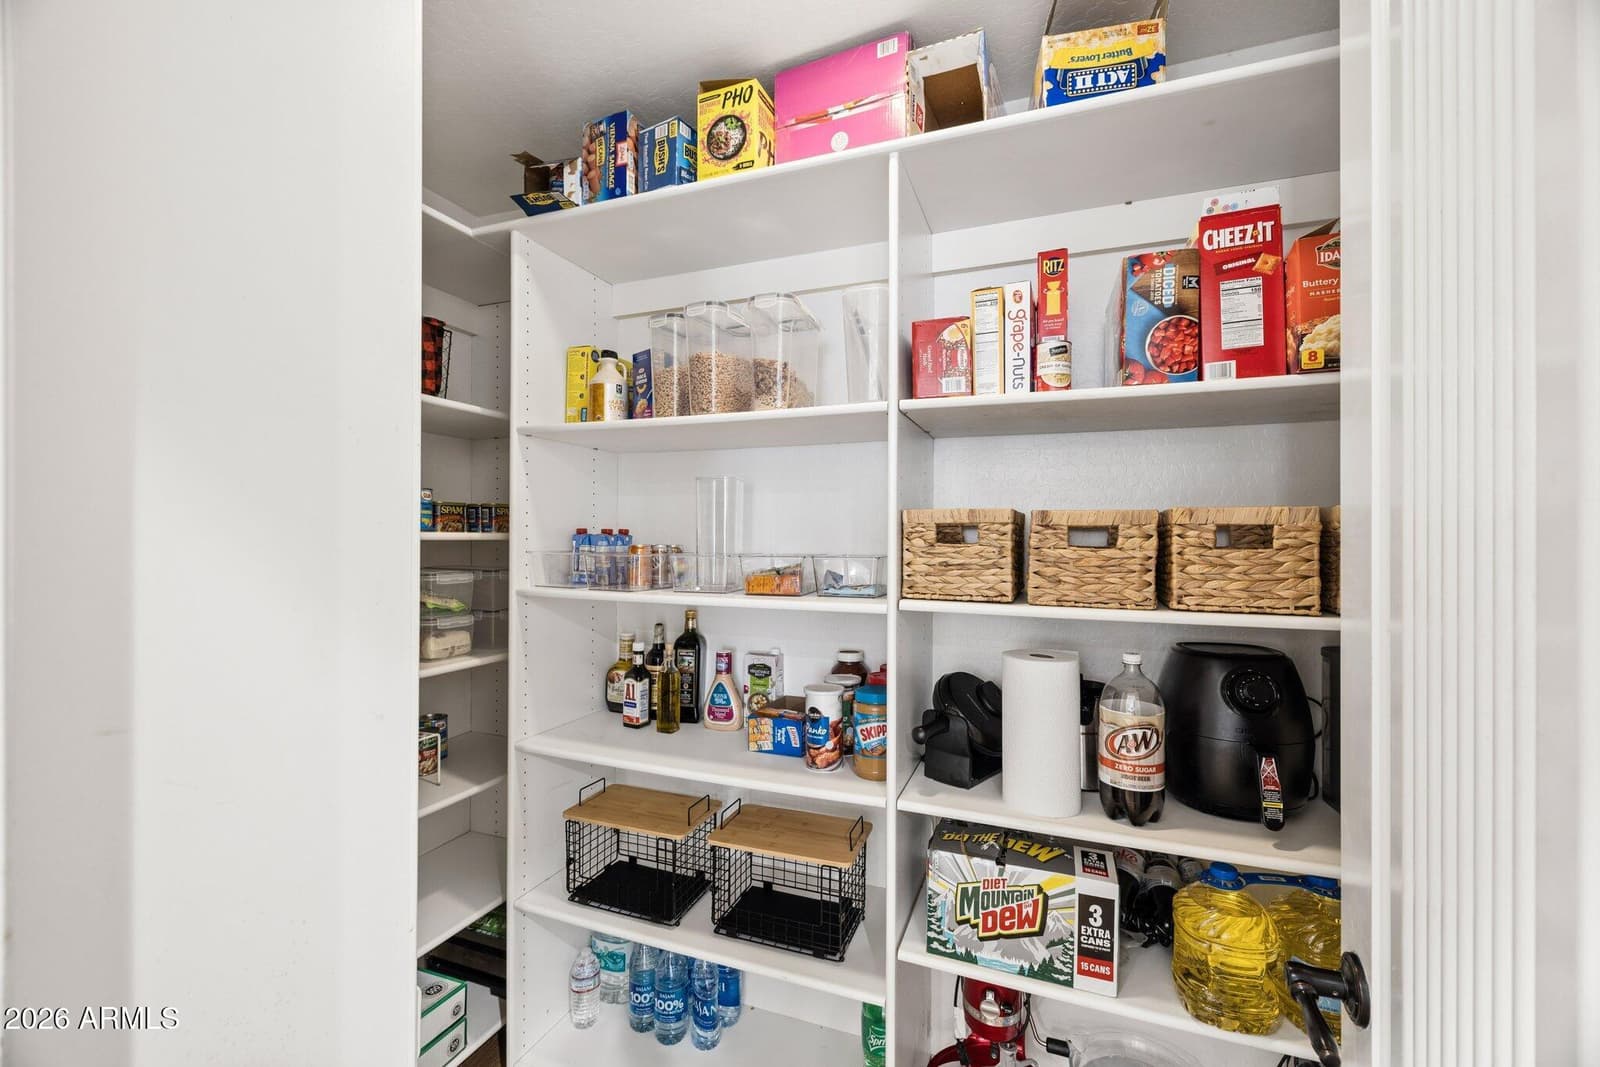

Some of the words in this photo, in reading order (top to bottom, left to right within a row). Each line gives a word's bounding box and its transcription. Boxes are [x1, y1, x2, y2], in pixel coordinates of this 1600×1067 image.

[1101, 48, 1133, 60] Butter
[1075, 73, 1095, 90] II
[1096, 69, 1130, 89] ACT
[722, 85, 753, 109] PHO
[657, 139, 666, 174] BUSH'S
[1042, 258, 1064, 274] RITZ
[1222, 257, 1256, 270] ORIGINAL
[1154, 269, 1163, 305] TOMATOES
[1162, 266, 1176, 305] DICED
[1302, 278, 1339, 288] Buttery
[1007, 309, 1028, 390] grape-nuts
[1308, 350, 1318, 361] 8
[440, 505, 463, 514] SPAM
[1115, 763, 1133, 772] ZERO
[972, 832, 1001, 842] THE
[982, 878, 1007, 890] DIET
[981, 898, 1040, 934] DEW
[1088, 904, 1103, 928] 3
[1080, 925, 1111, 940] EXTRA
[1080, 936, 1111, 948] CANS
[1081, 961, 1089, 971] 15
[1090, 963, 1111, 976] CANS
[655, 998, 684, 1011] 100%
